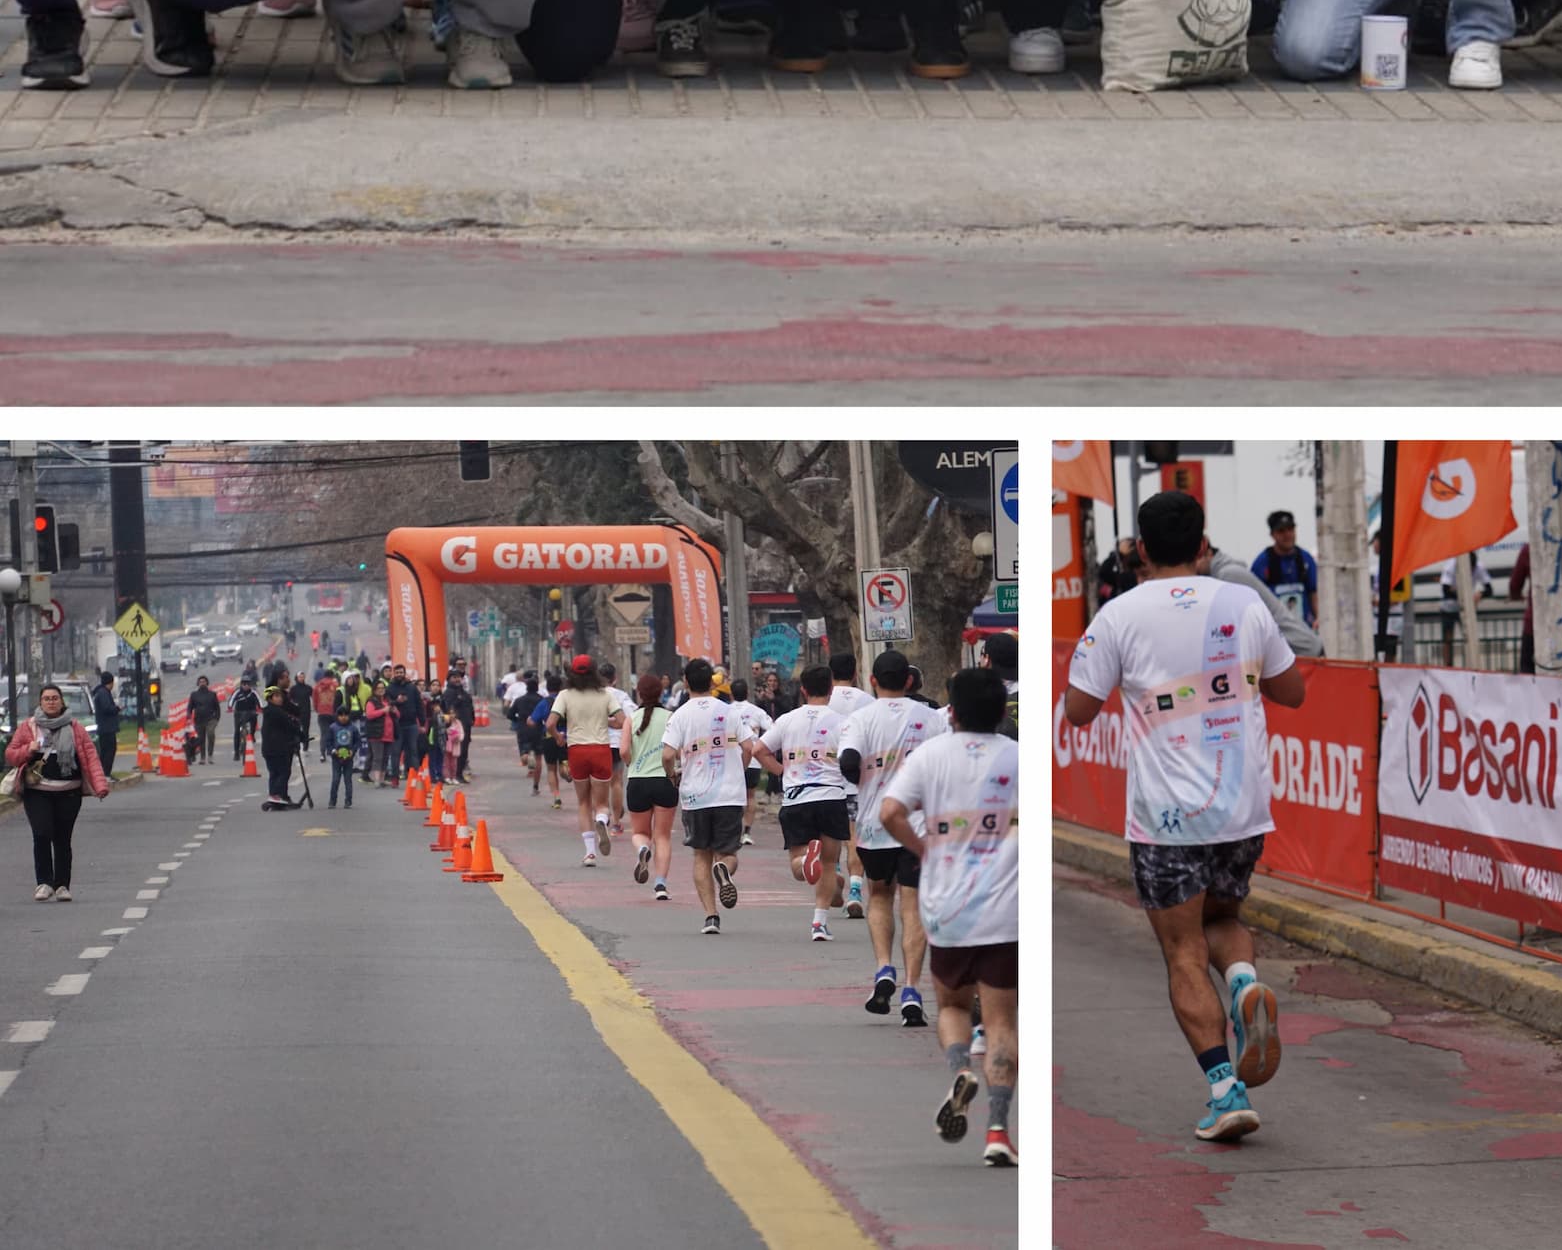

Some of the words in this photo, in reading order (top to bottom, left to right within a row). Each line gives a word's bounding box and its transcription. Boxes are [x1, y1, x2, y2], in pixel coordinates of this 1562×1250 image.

[493, 542, 668, 570] GATORAD
[1211, 674, 1230, 695] G
[1438, 693, 1559, 811] Basani
[1451, 846, 1493, 886] QUÍMICOS
